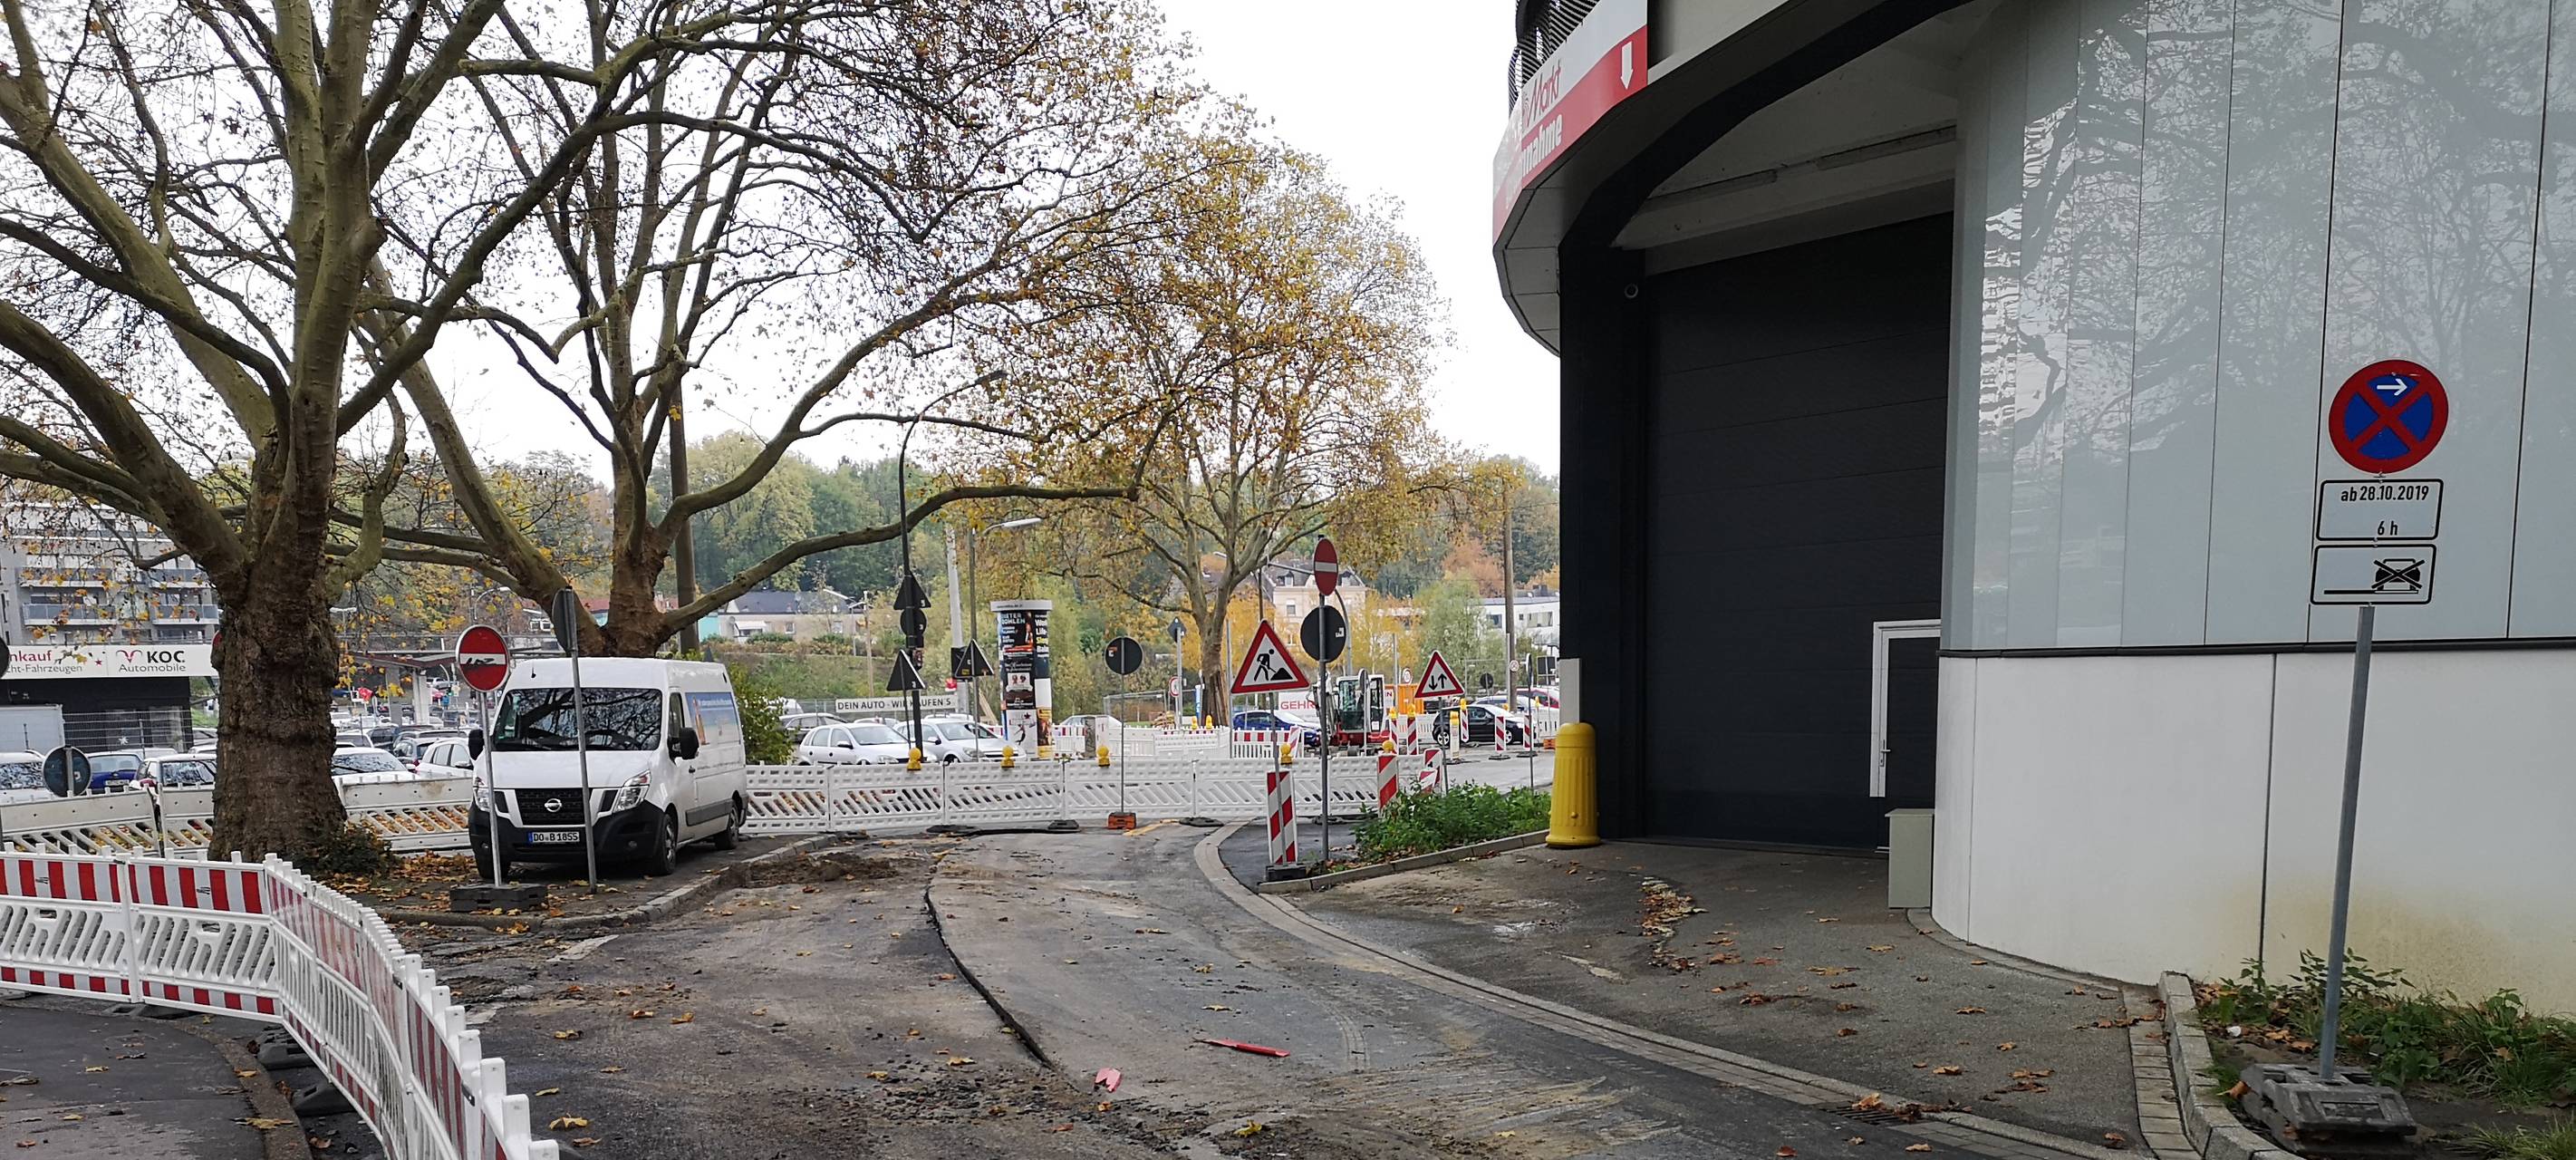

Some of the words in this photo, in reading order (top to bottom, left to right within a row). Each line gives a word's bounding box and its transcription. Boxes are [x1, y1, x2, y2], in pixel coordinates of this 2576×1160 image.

[1526, 59, 1561, 128] Markt
[2340, 487, 2358, 501] ab
[2359, 485, 2429, 500] 28.10.2019
[2377, 520, 2385, 536] 6
[2389, 520, 2398, 536] h
[9, 651, 53, 662] nkauf
[6, 662, 83, 674] cht-Fahrzeugen
[118, 663, 187, 672] Automobile
[837, 701, 859, 710] DEIN
[861, 701, 885, 710] AUTO
[534, 833, 545, 842] DO
